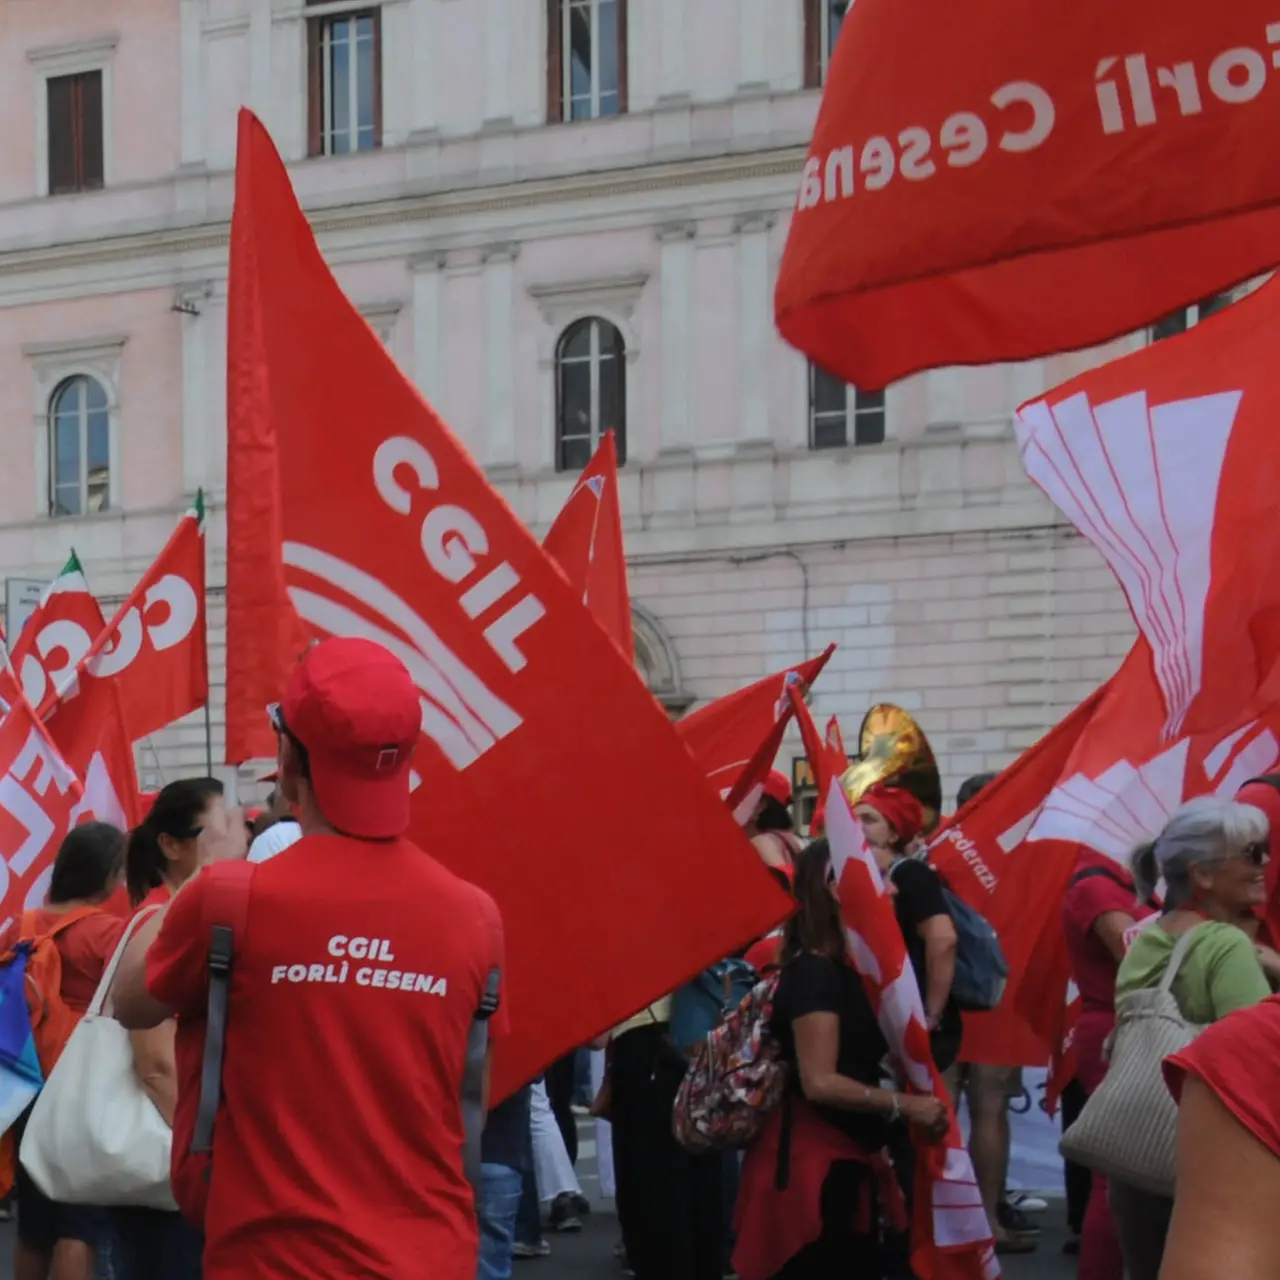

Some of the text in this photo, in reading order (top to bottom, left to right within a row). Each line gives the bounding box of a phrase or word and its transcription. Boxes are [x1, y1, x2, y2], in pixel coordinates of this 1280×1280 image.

[372, 435, 547, 674] CGIL
[327, 934, 395, 962] CGIL
[355, 966, 447, 997] CESENA
